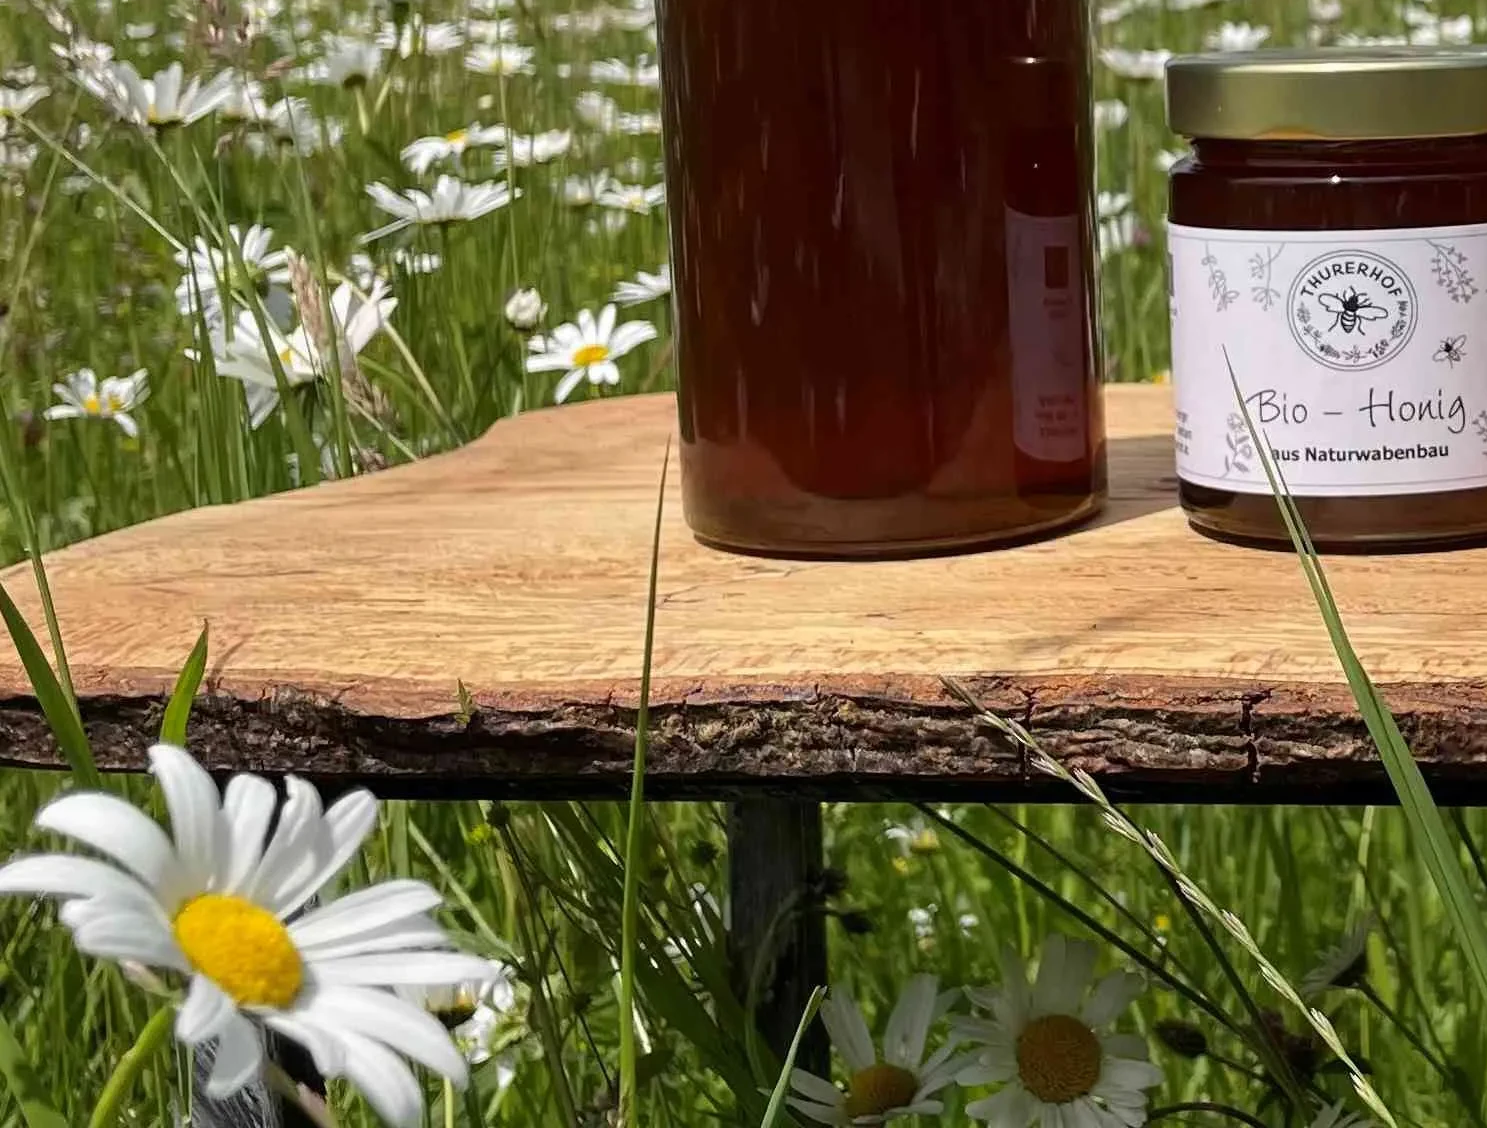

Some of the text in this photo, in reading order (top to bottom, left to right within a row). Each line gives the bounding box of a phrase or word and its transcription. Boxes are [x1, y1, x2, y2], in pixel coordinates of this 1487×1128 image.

[1300, 261, 1402, 297] THURERHOF
[1245, 389, 1308, 424] Bio
[1359, 387, 1466, 434] Honig
[1272, 443, 1449, 462] aus Naturwabenbau
